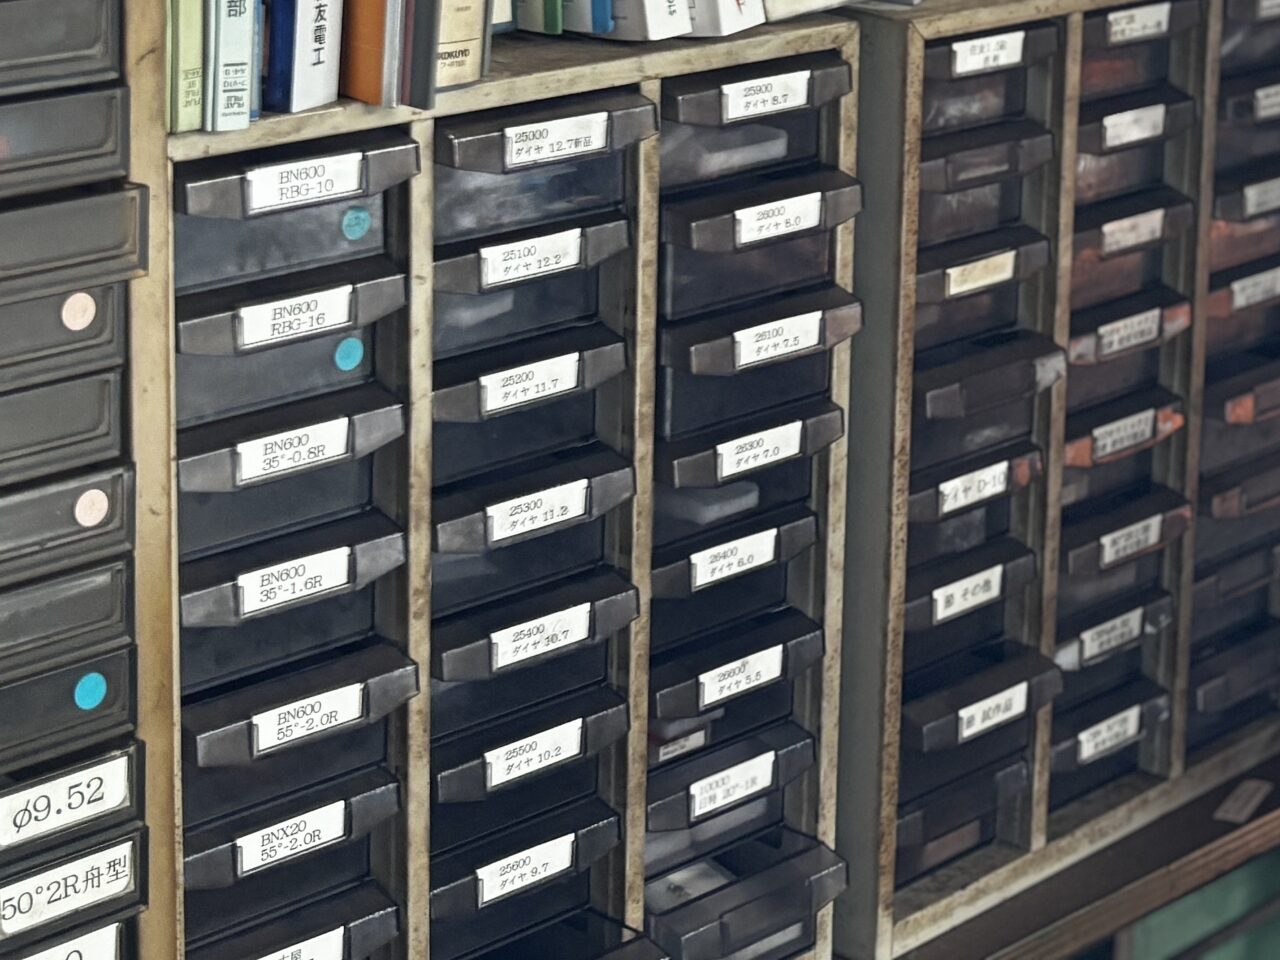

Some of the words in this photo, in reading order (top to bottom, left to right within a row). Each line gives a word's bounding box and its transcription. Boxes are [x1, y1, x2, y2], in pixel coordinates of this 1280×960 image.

[279, 164, 325, 185] BN600
[279, 179, 334, 201] RBG-10
[271, 299, 318, 321] BN600
[270, 313, 326, 337] RBG-16
[263, 433, 310, 456] BN600
[260, 563, 306, 588] BN600
[276, 710, 339, 742] 55°-2.0R
[277, 701, 322, 727] BN600
[260, 820, 307, 848] BNX20
[260, 829, 322, 862] 55°-2.0R
